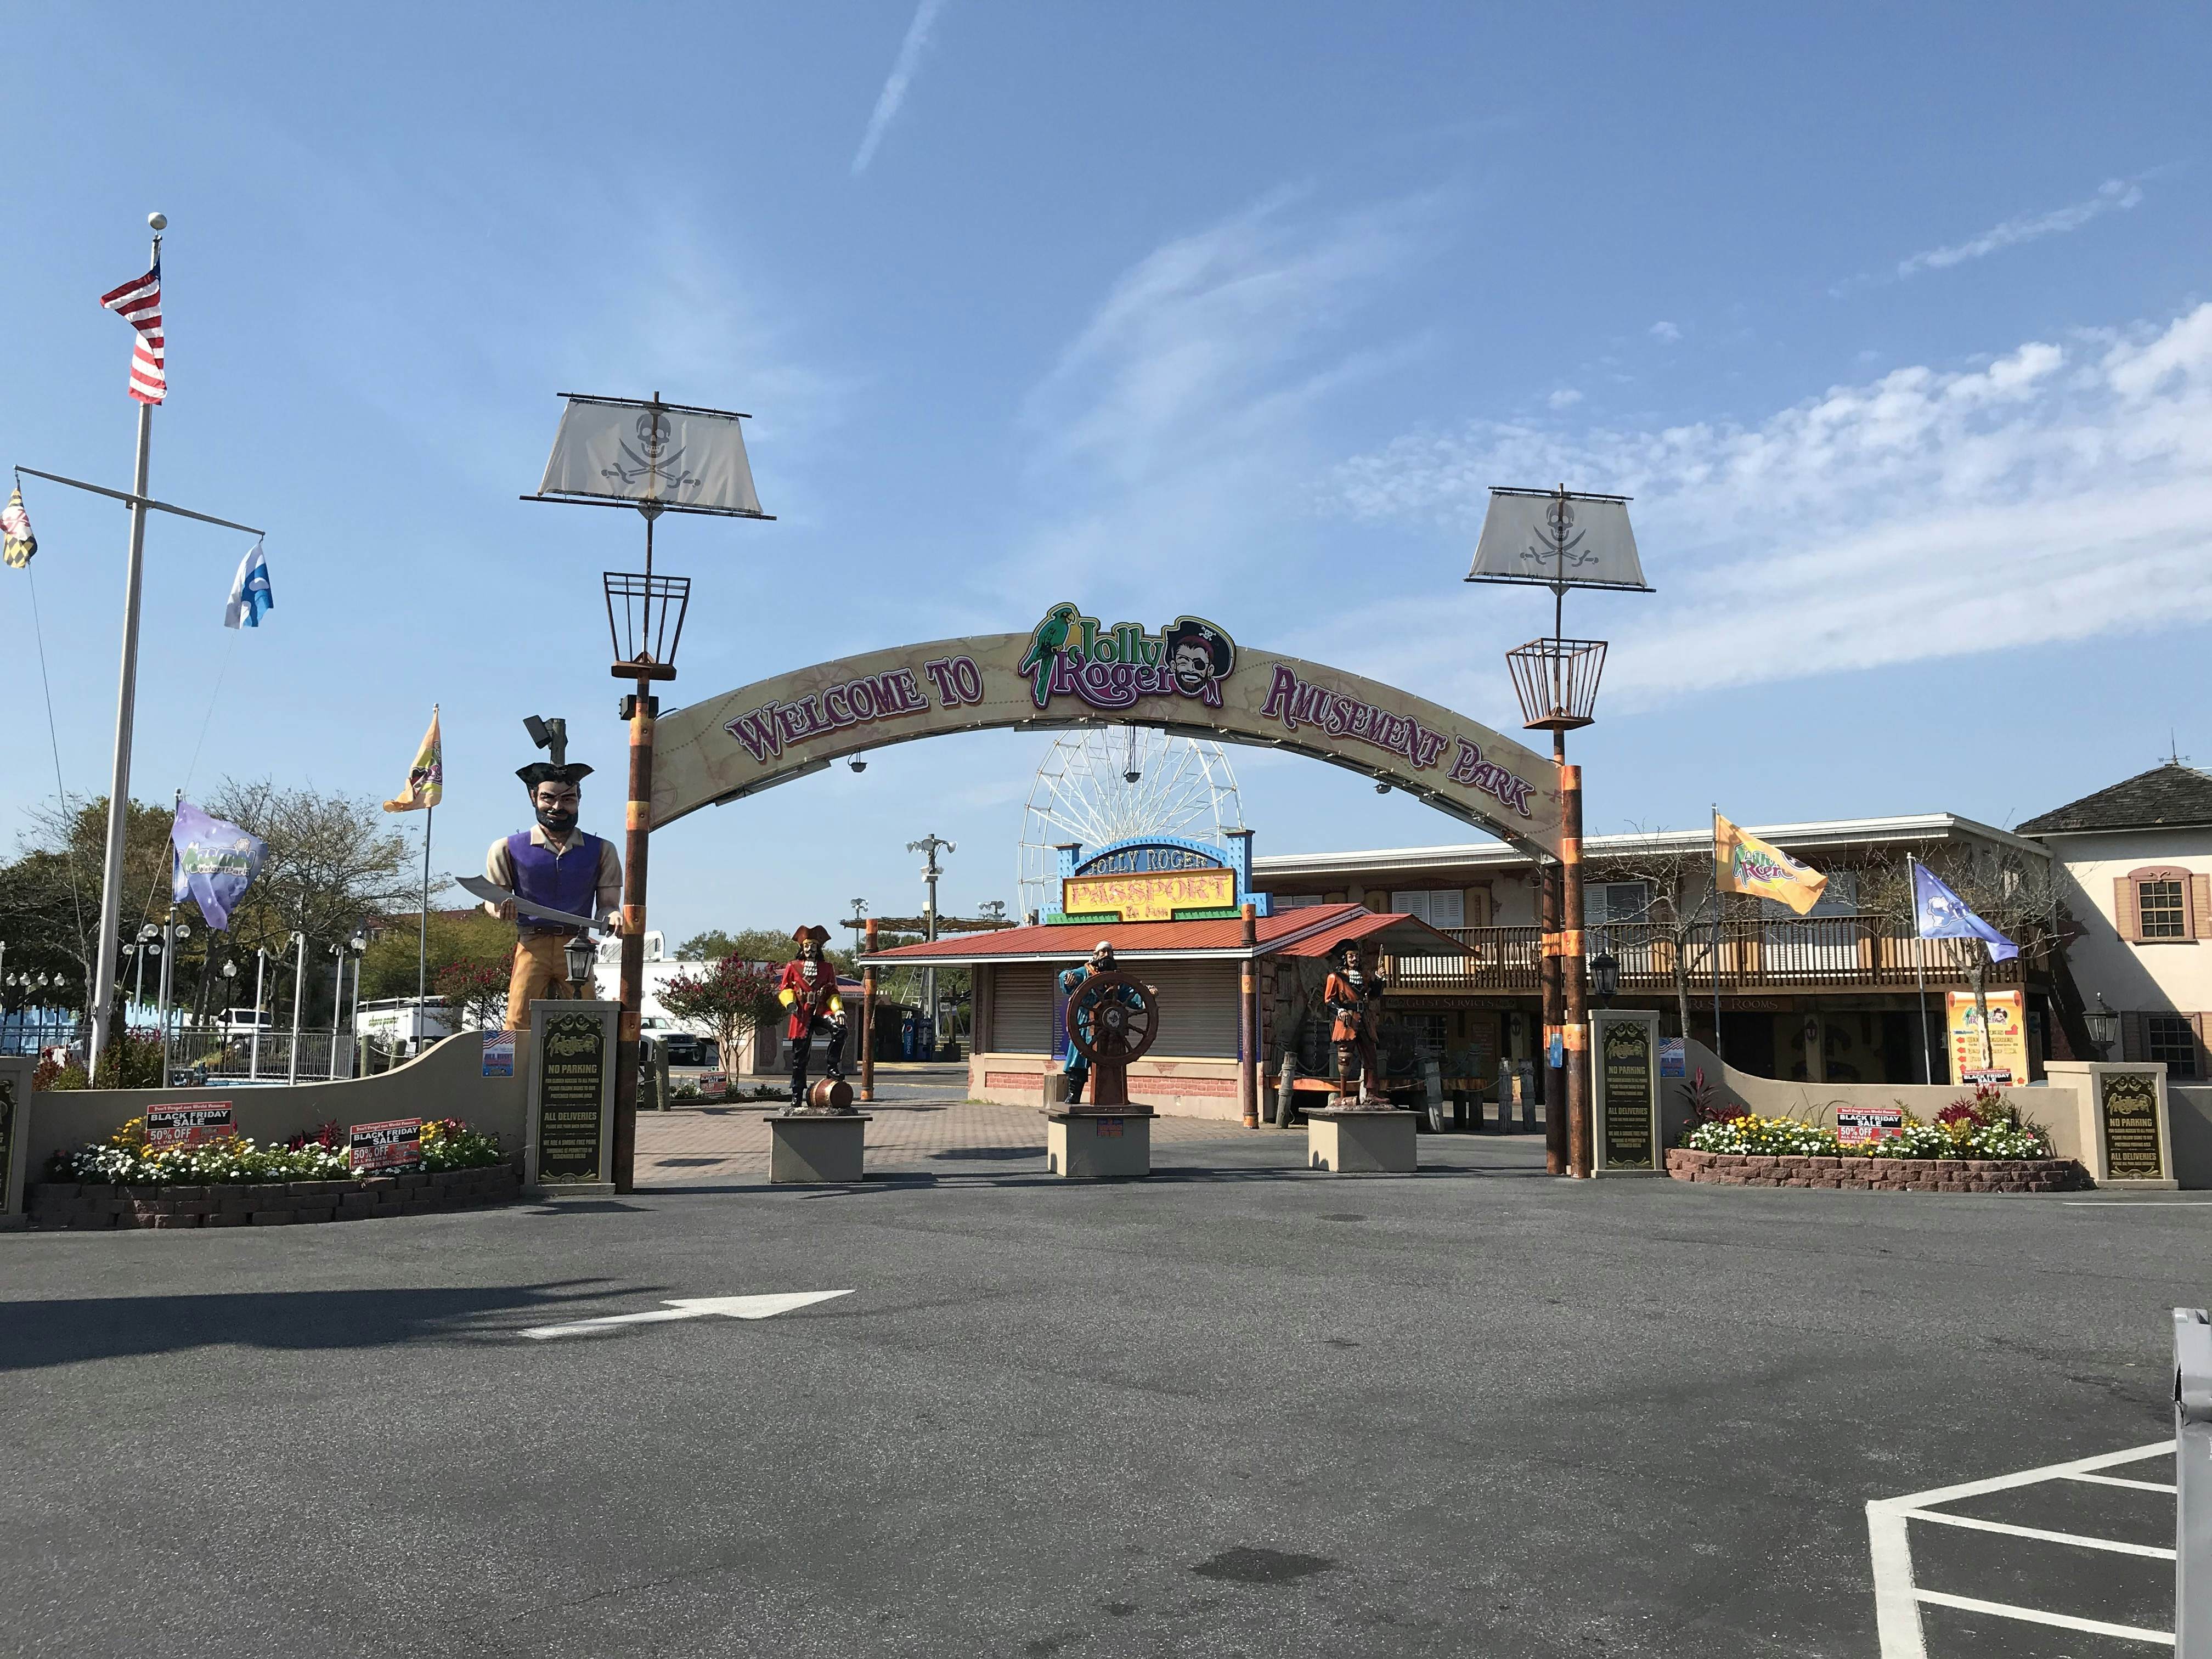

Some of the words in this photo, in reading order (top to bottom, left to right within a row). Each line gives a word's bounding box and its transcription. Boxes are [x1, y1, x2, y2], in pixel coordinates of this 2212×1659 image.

[1067, 621, 1164, 673] Jolly
[1055, 651, 1172, 703] Roger
[724, 668, 929, 762] WELCOME
[924, 656, 983, 707] TO
[1260, 663, 1448, 768] AMUSEMENT
[1447, 734, 1534, 816] PARK
[1087, 850, 1139, 874] JOLLY
[1147, 849, 1207, 870] ROGER
[1071, 874, 1230, 906] PASSPORT
[1406, 997, 1440, 1007] GUEST
[1444, 997, 1493, 1007] SERVICES
[1689, 998, 1724, 1010] REST
[1731, 998, 1778, 1011] ROOMS
[549, 1064, 560, 1074] NO
[562, 1064, 597, 1074] PARKING
[1609, 1066, 1617, 1074] NO
[1619, 1066, 1645, 1074] PARKING
[151, 1113, 187, 1121] BLACK
[190, 1110, 228, 1119] FRIDAY
[544, 1112, 556, 1120] ALL
[558, 1112, 597, 1120] DELIVERIES
[173, 1118, 205, 1127] SALE
[2109, 1119, 2120, 1127] NO
[2121, 1118, 2152, 1127] PARKING
[150, 1129, 172, 1141] 50%
[174, 1128, 191, 1139] OFF
[354, 1131, 384, 1141] BLACK
[387, 1127, 418, 1136] FRIDAY
[1841, 1127, 1858, 1135] 50%
[373, 1136, 399, 1145] SALE
[354, 1148, 373, 1159] 50%
[374, 1146, 389, 1156] OFF
